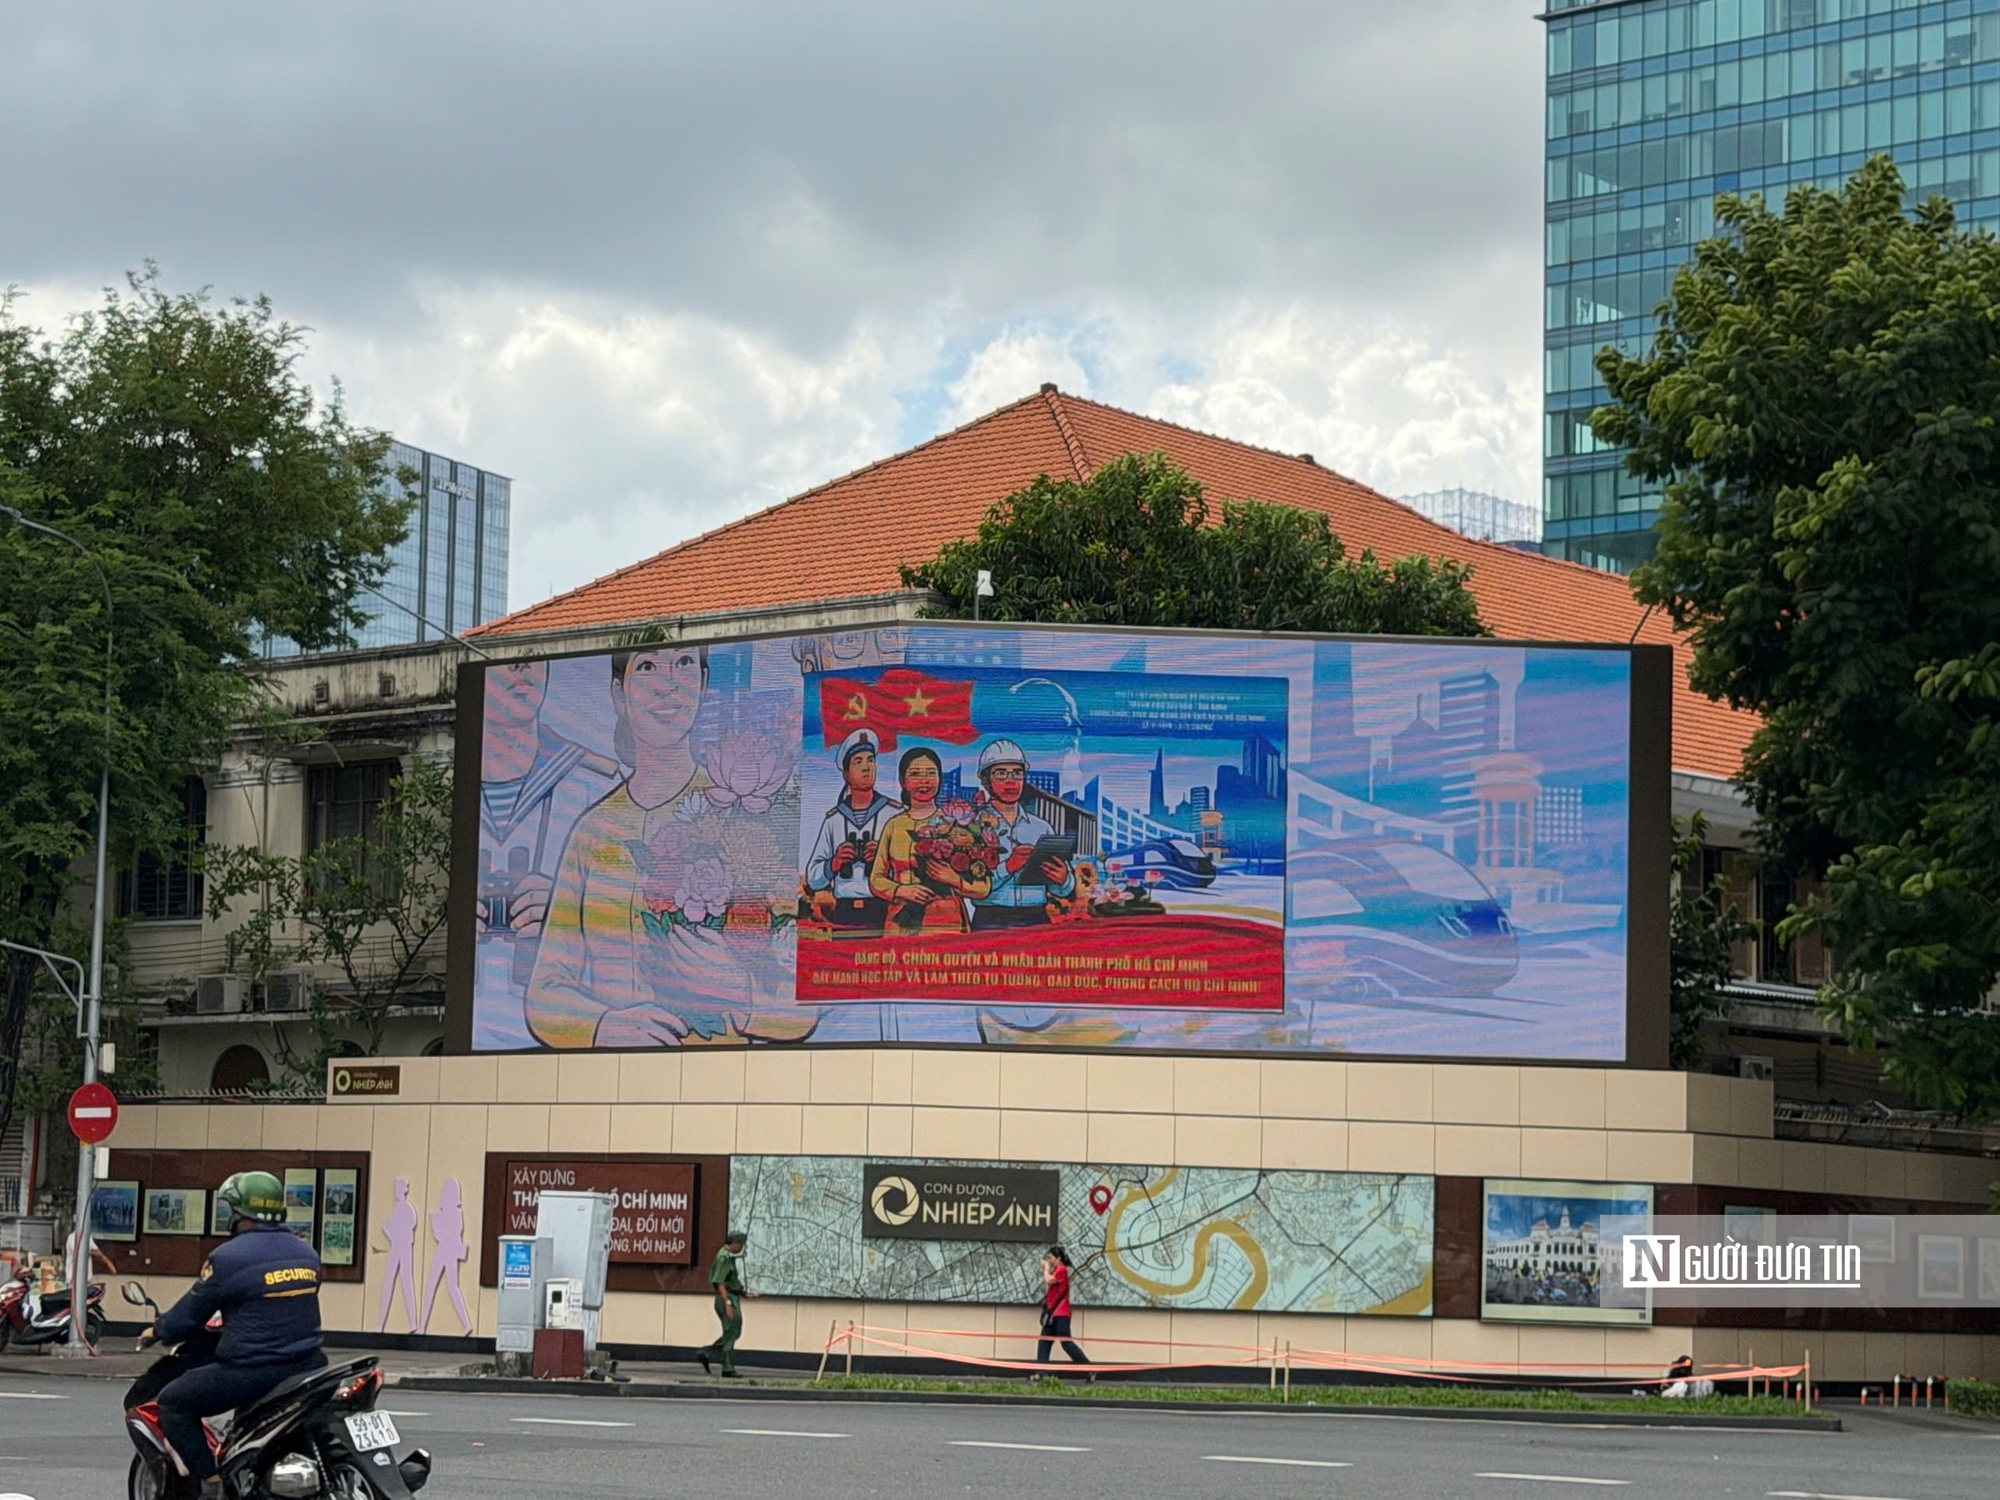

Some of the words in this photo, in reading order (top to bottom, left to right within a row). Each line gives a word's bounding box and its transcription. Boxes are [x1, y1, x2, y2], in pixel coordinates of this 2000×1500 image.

[513, 1167, 538, 1185] XÂY
[540, 1168, 576, 1188] DỰNG
[512, 1187, 540, 1207] THÀ
[622, 1189, 648, 1210] CHÍ
[650, 1193, 688, 1210] MINH
[923, 1183, 952, 1195] CON
[922, 1197, 996, 1225] NHIẾP
[511, 1211, 536, 1230] VĂN
[661, 1215, 685, 1234] MỚI
[633, 1236, 653, 1255] HỘI
[655, 1237, 686, 1257] NHẬP
